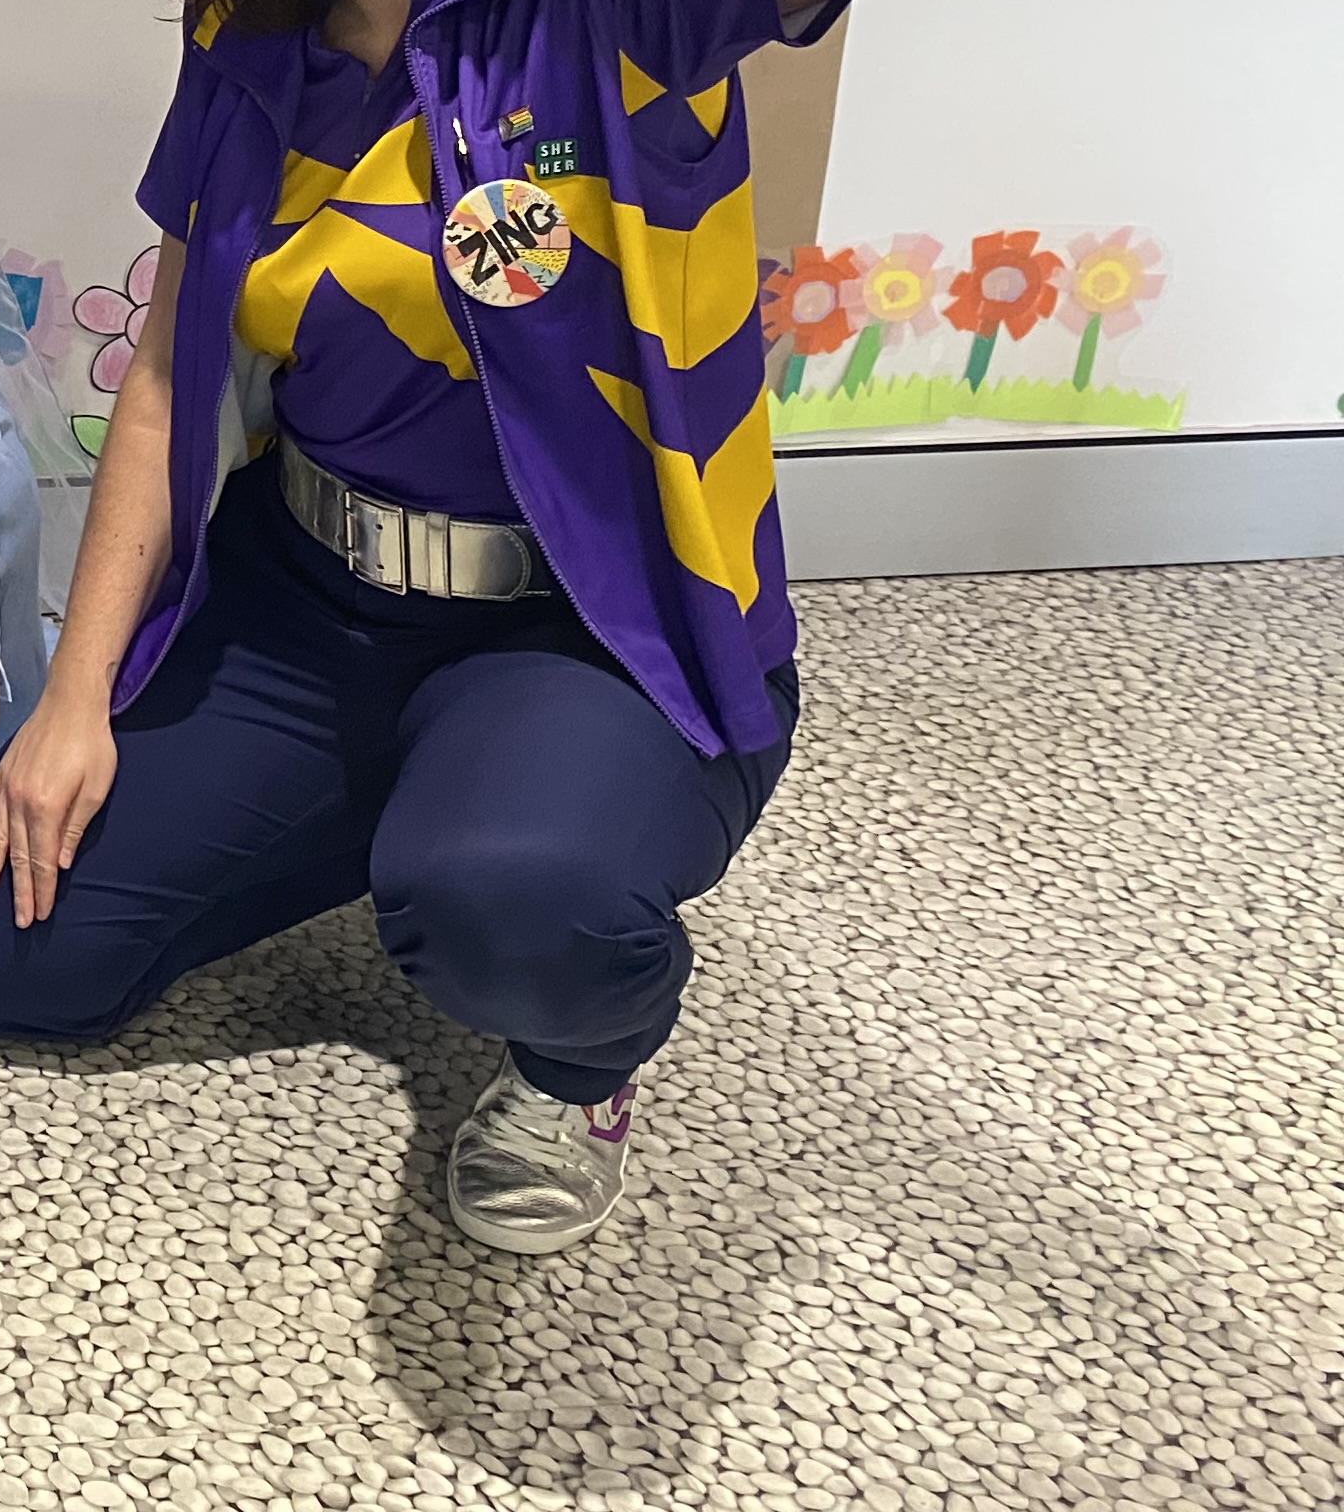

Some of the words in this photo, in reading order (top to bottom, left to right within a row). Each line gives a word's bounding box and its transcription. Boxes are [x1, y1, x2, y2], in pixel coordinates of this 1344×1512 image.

[539, 141, 574, 156] SHE
[539, 158, 575, 175] HER
[457, 202, 560, 286] ZING
